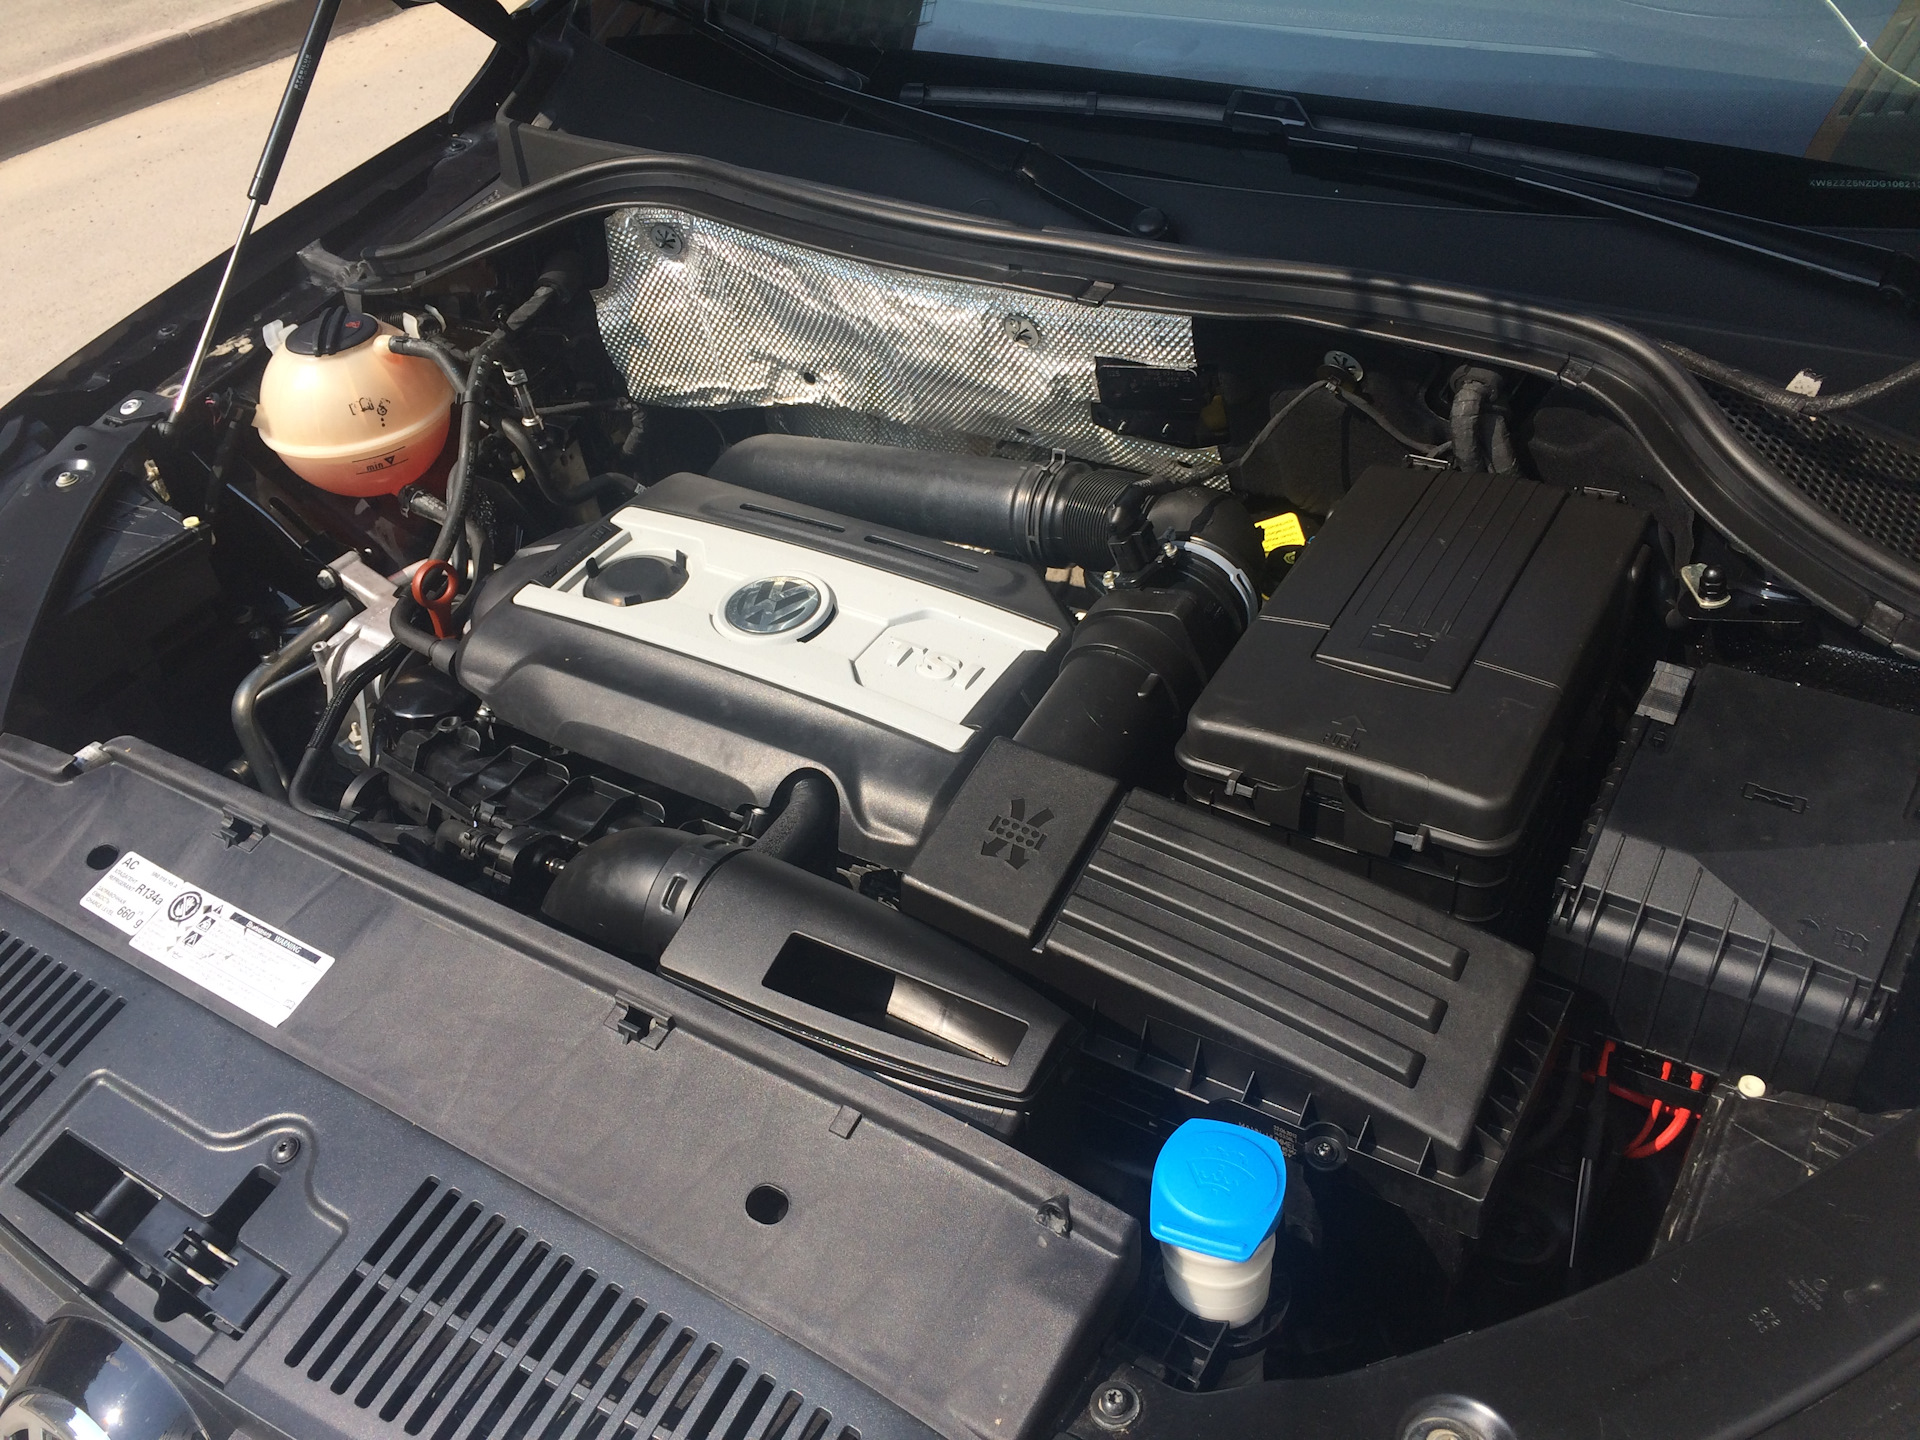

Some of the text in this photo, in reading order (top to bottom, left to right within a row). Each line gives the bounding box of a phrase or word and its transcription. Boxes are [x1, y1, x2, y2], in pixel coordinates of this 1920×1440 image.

[366, 461, 384, 472] min
[885, 635, 986, 691] TSI
[1321, 731, 1361, 751] PUSH
[122, 857, 140, 870] AC
[135, 883, 164, 906] R134a
[116, 905, 136, 920] 660
[274, 935, 302, 953] WARNING
